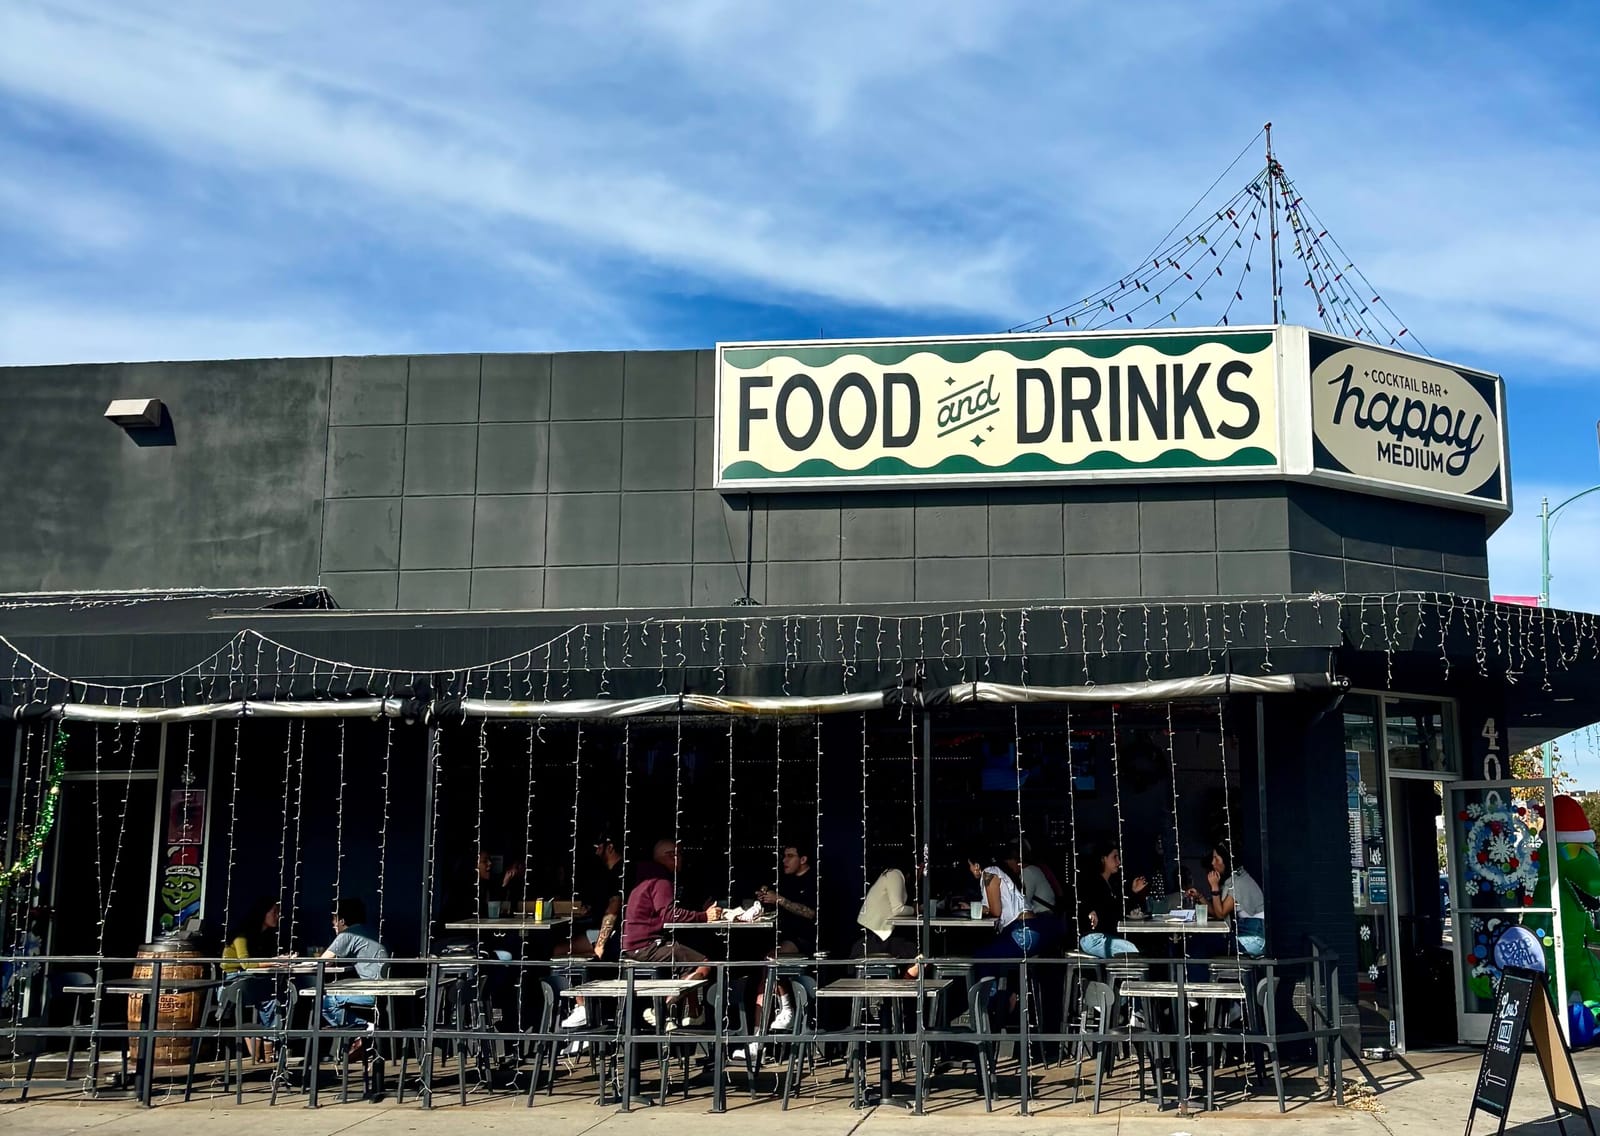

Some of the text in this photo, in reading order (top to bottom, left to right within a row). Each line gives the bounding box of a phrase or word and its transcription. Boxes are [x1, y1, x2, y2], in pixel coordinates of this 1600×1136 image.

[738, 360, 1261, 452] FOOD and DRINKS
[1371, 369, 1442, 398] COCKTAIL BAR
[1327, 364, 1484, 476] happy
[1377, 440, 1444, 473] MEDIUM
